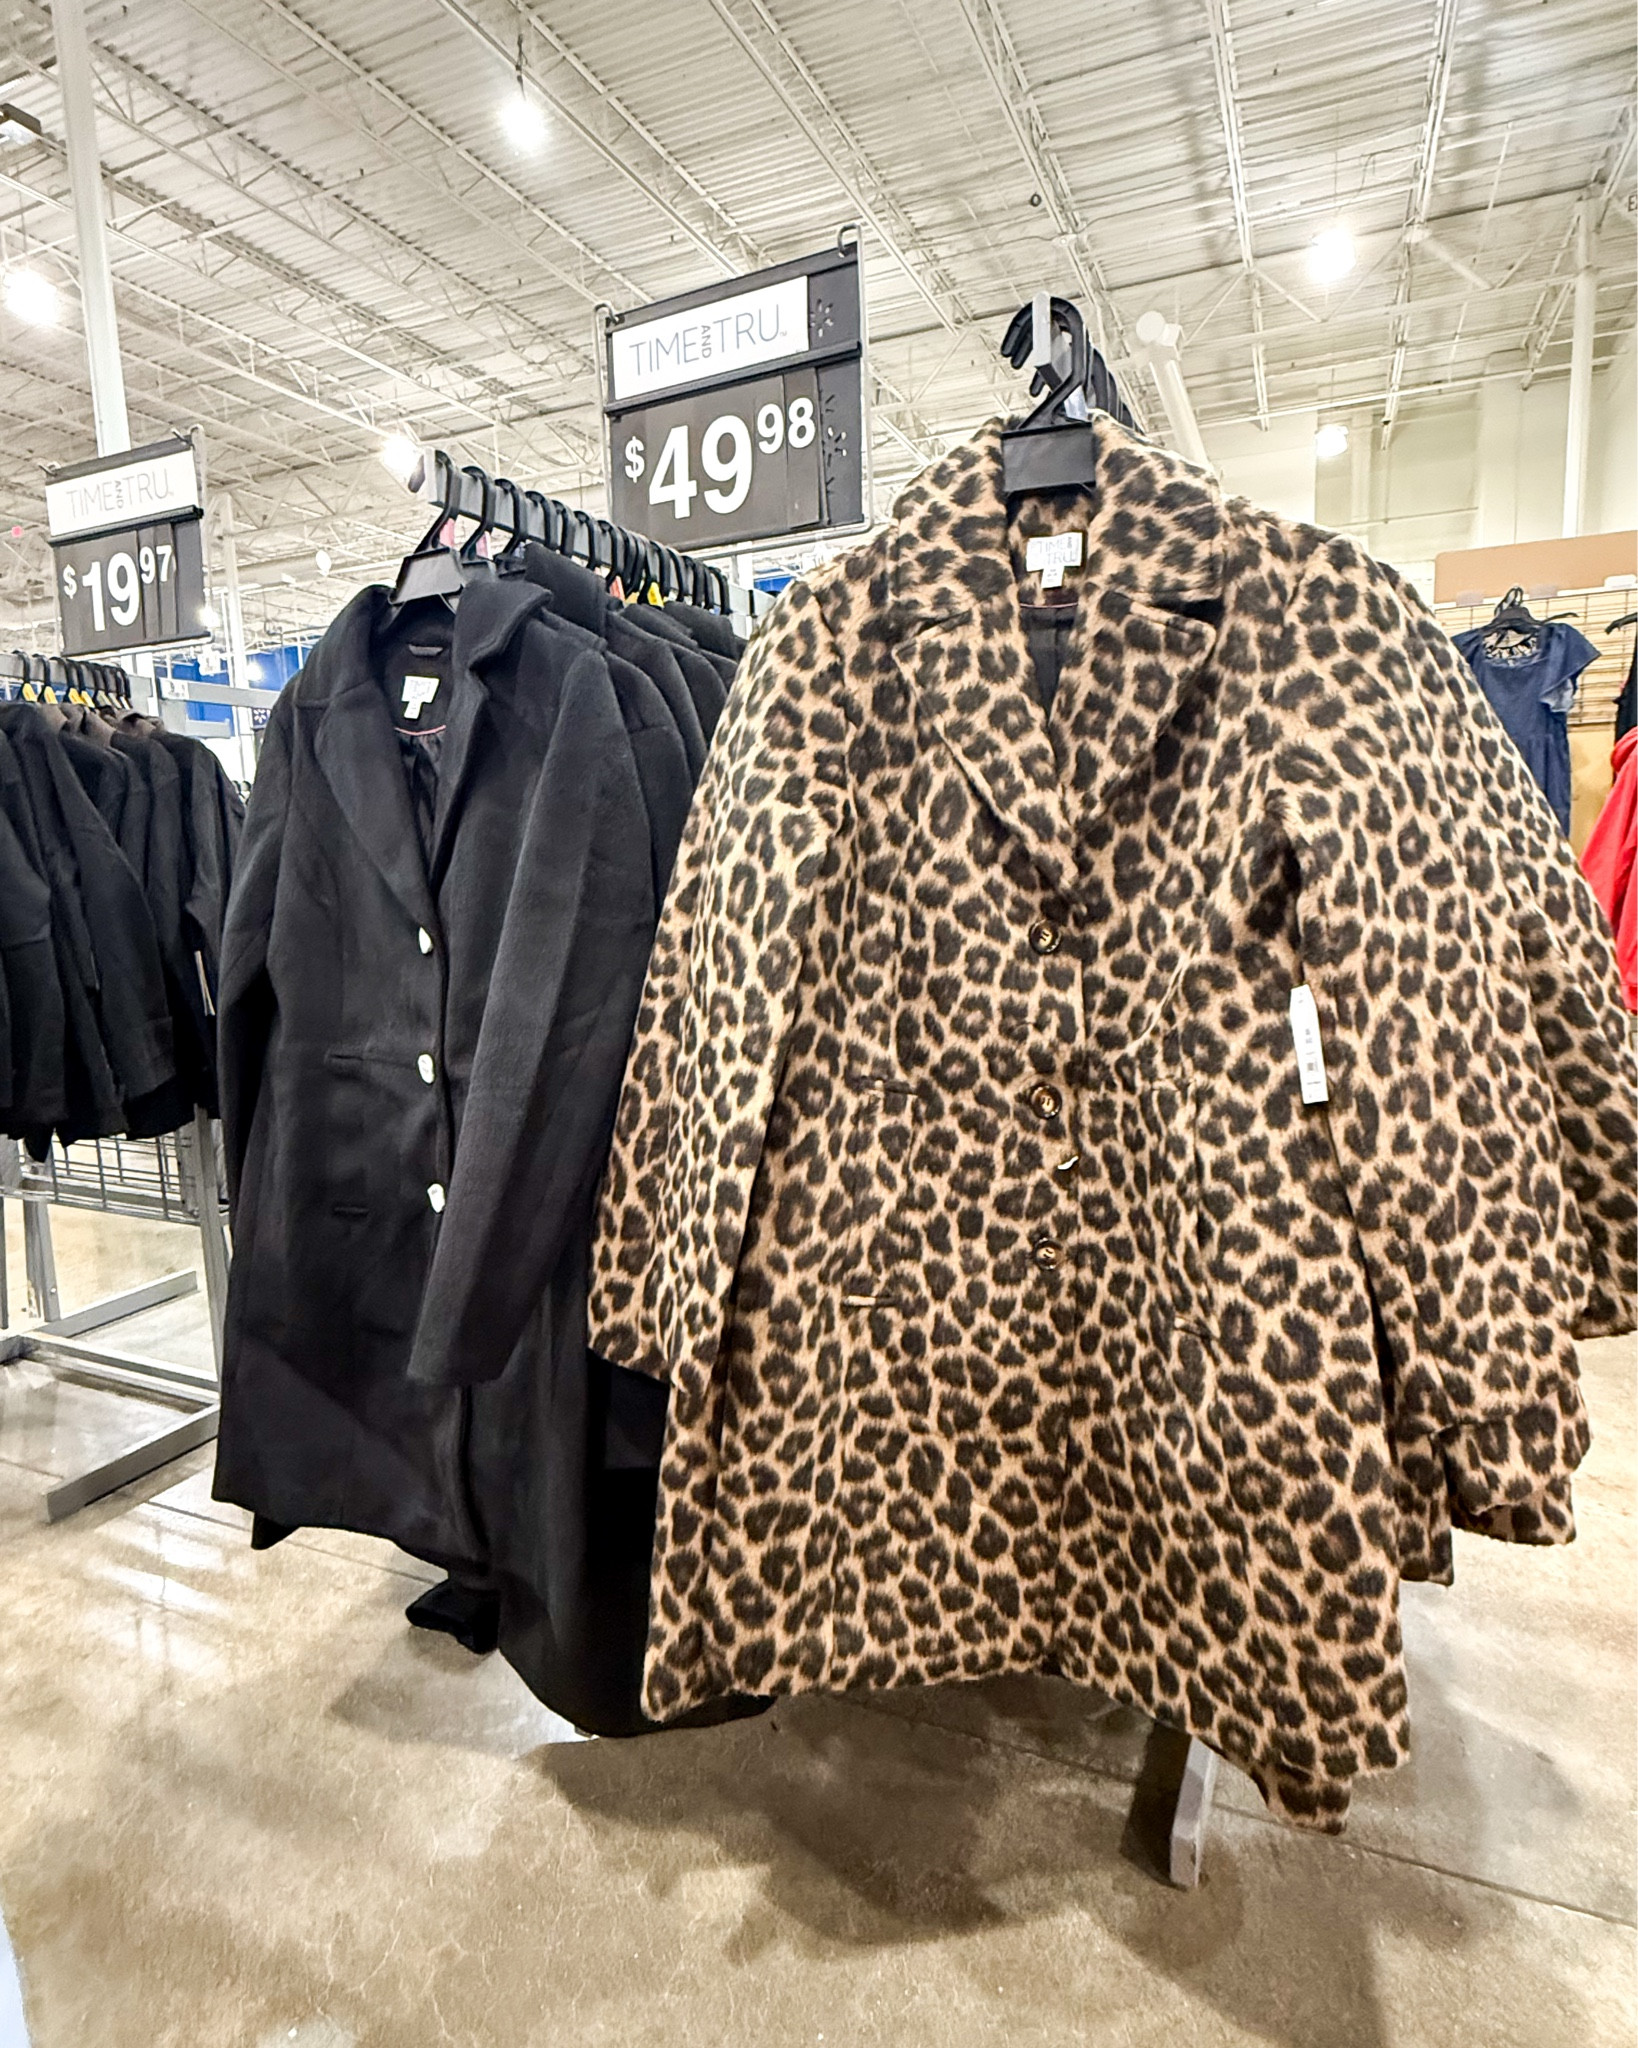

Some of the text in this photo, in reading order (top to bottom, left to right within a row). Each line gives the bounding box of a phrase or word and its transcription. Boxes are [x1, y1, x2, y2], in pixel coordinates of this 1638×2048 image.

[629, 304, 779, 376] TIME AND TRU
[66, 481, 115, 519] TIME
[122, 468, 169, 505] TRU
